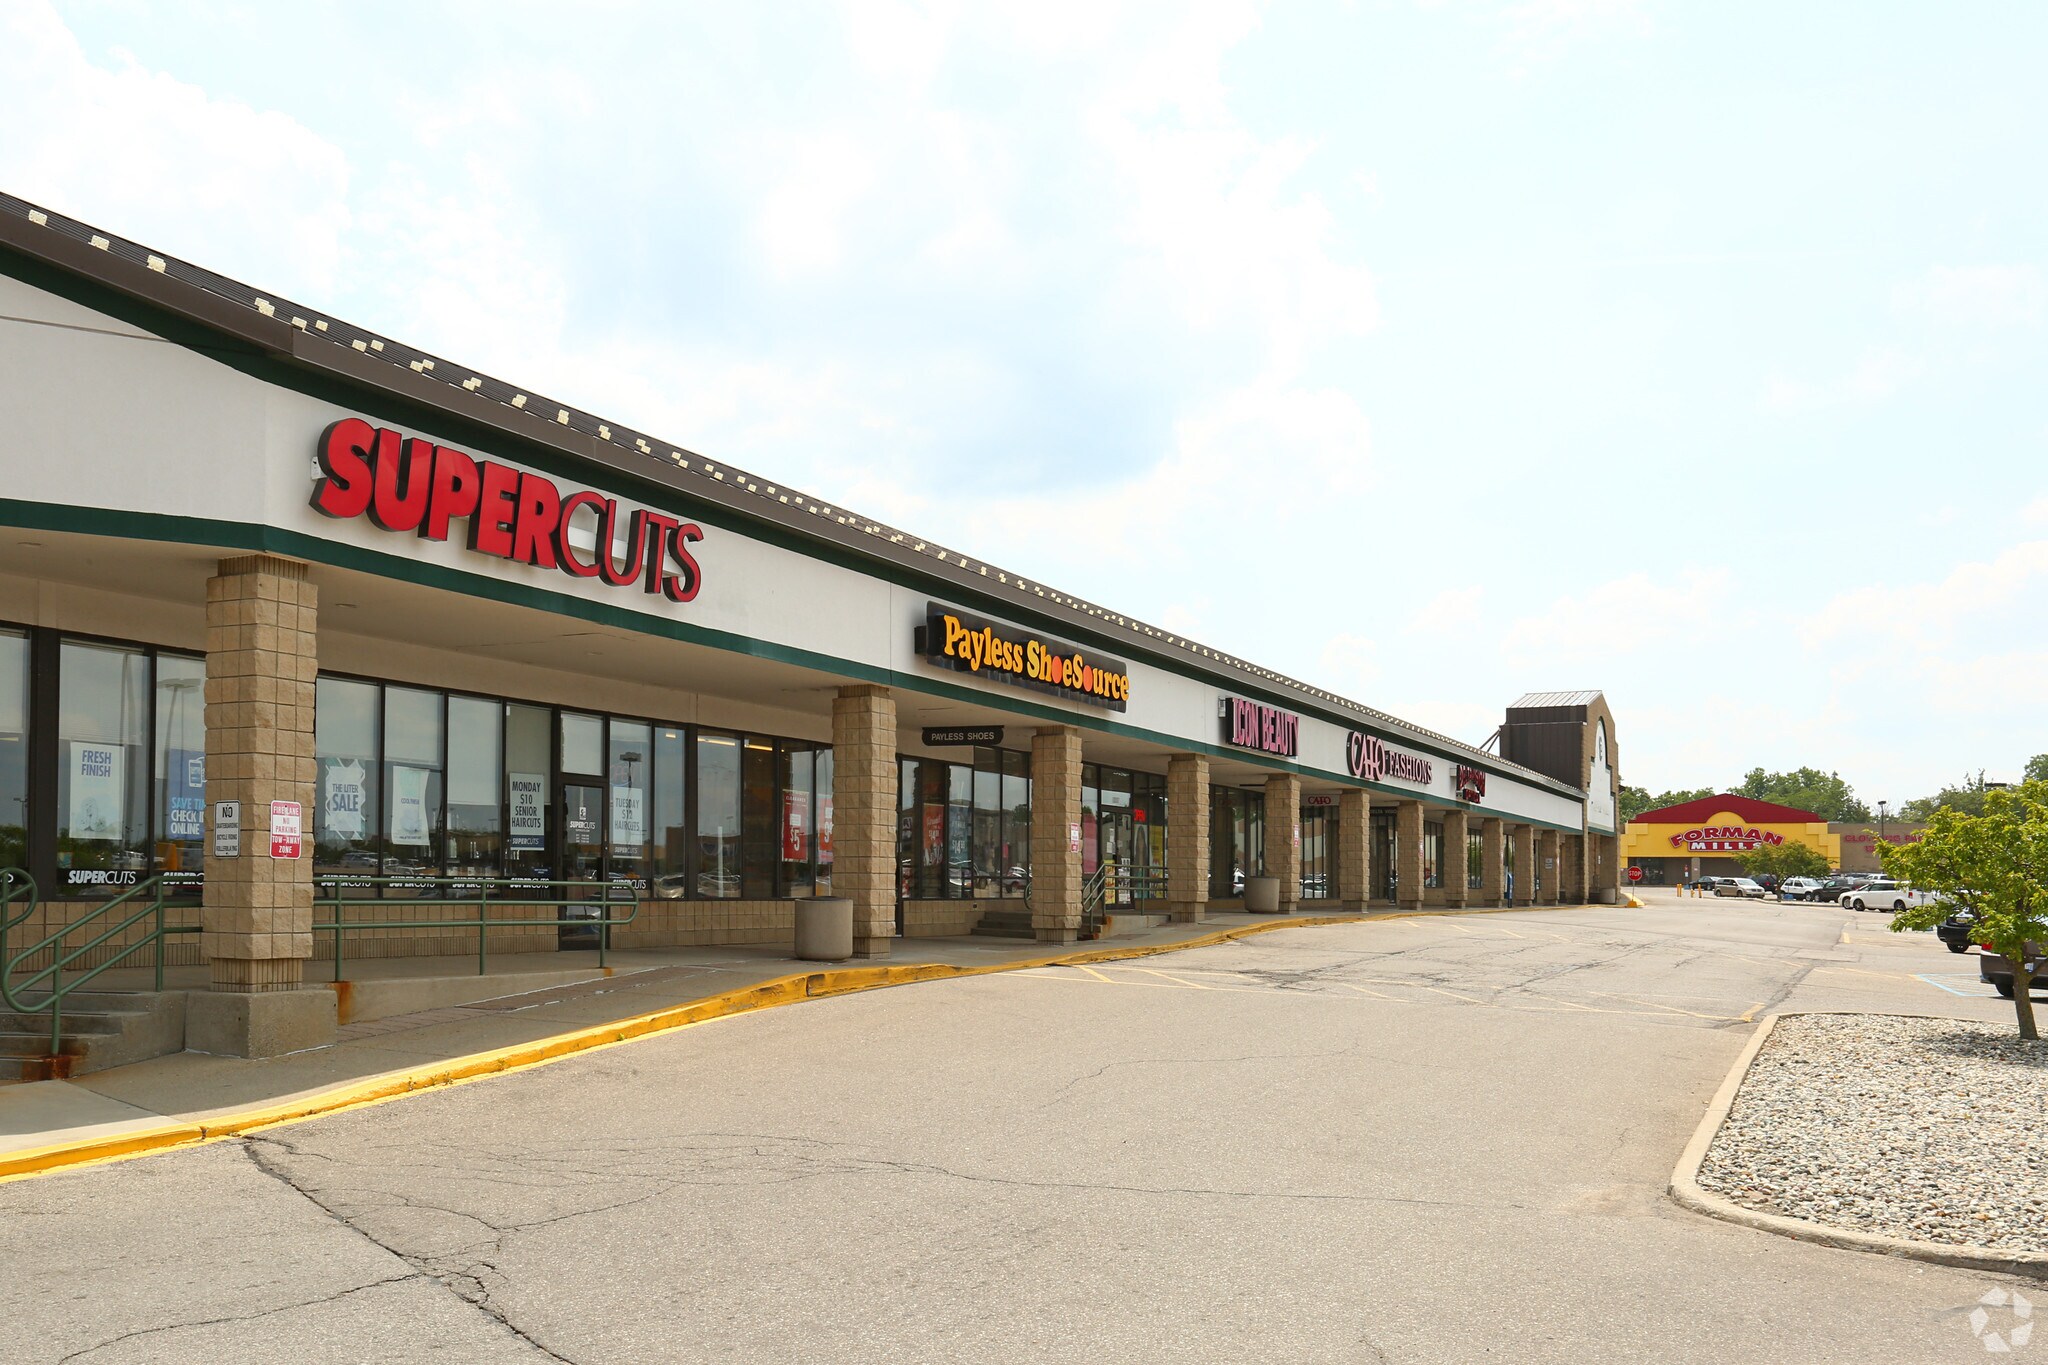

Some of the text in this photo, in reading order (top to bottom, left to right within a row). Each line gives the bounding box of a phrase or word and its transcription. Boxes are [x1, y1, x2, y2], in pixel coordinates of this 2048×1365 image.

[310, 417, 703, 602] SUPERCUTS
[944, 614, 1130, 701] Payless ShoeSource
[1233, 698, 1300, 756] ICON BEAUTY
[931, 731, 994, 741] PAYLESS SHOES
[81, 750, 112, 765] FRESH
[1350, 731, 1386, 781] CATO
[1389, 750, 1433, 785] FASHIONS
[81, 763, 111, 778] FINISH
[332, 783, 359, 793] THE LITER
[511, 781, 541, 793] MONDAY
[171, 797, 192, 810] SAVE
[332, 793, 359, 812] SALE
[615, 798, 640, 809] TUESDAY
[1308, 796, 1331, 805] CATO
[170, 809, 197, 823] CHECK
[222, 806, 233, 818] NO
[515, 806, 537, 818] SENIOR
[170, 822, 200, 835] ONLINE
[511, 817, 541, 829] HAIRCUTS
[569, 821, 596, 830] SUPERCUTS
[614, 820, 640, 831] HAIRCUTS
[275, 826, 297, 834] PARKING
[272, 835, 300, 844] TOW-AWAY
[512, 837, 539, 845] SUPERCUTS
[1669, 826, 1785, 848] FORMAN
[278, 845, 292, 854] ZONE
[614, 846, 638, 854] SUPERCUTS
[68, 870, 137, 884] SUPERCUTS
